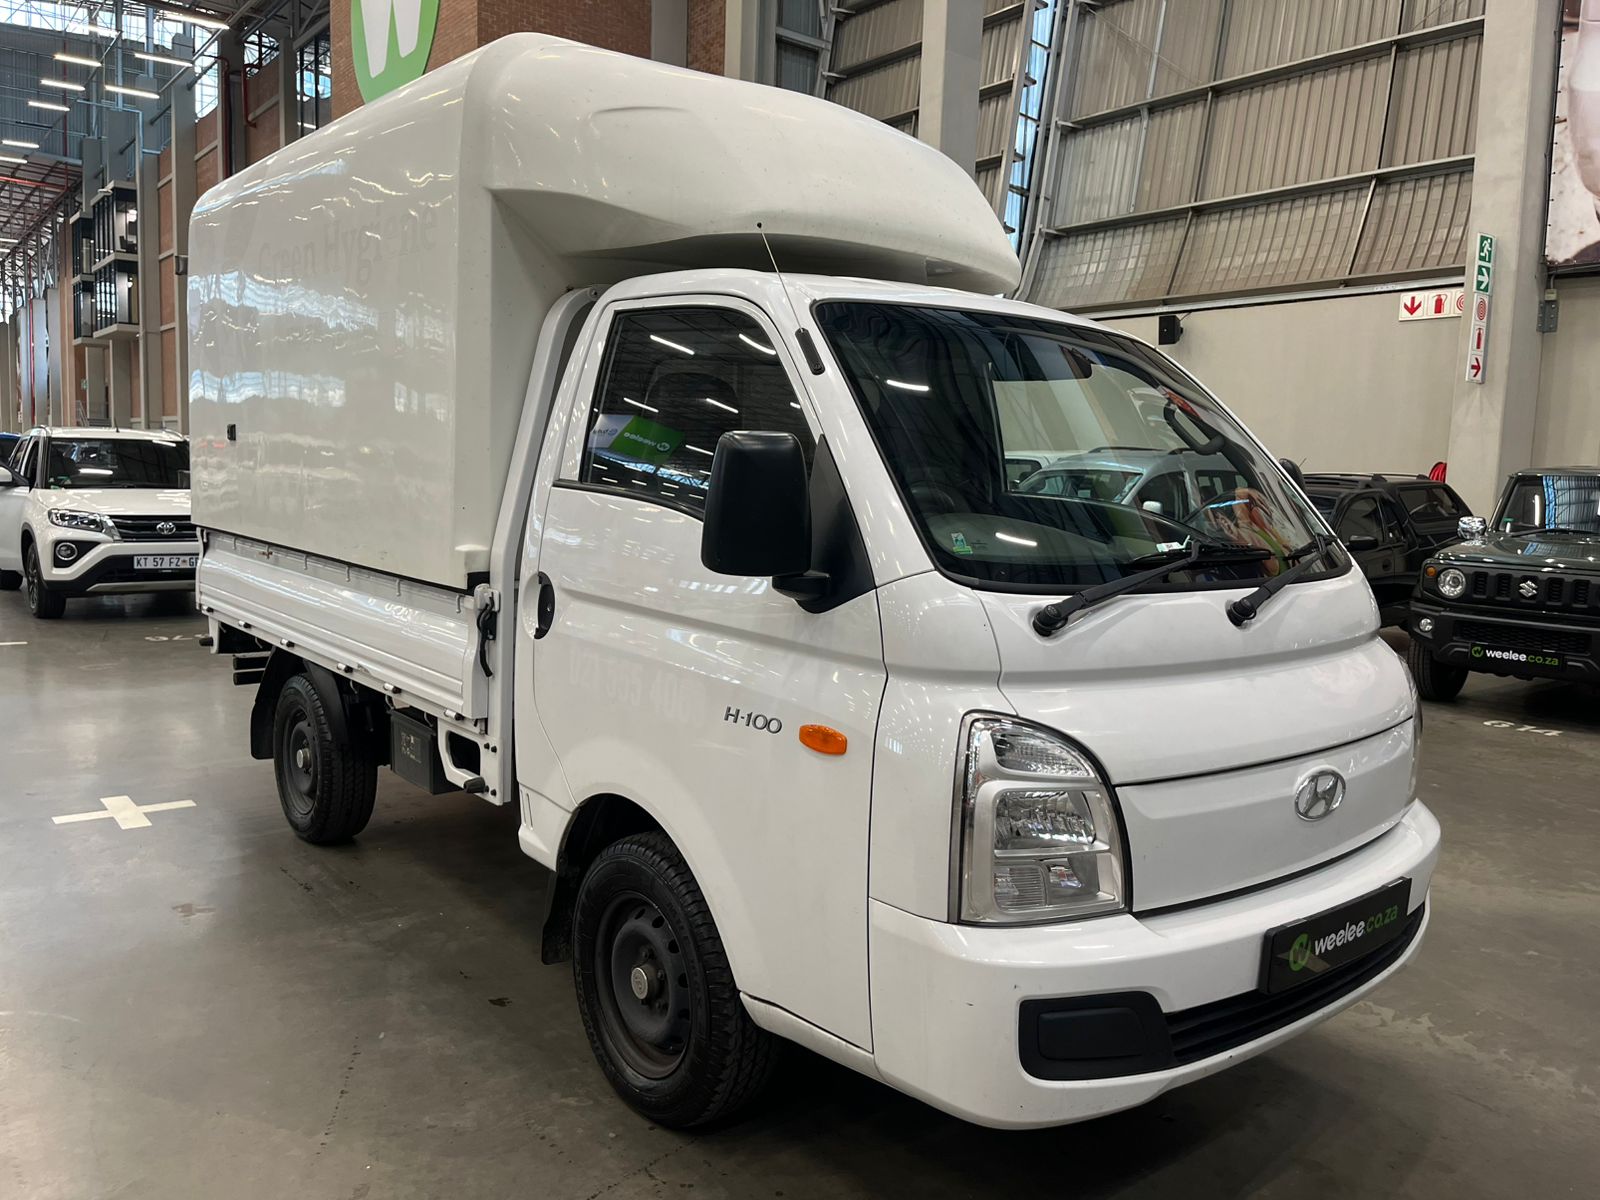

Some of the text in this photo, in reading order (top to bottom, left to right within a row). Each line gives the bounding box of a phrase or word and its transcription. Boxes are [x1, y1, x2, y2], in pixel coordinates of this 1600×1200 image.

[136, 557, 148, 568] KT
[152, 557, 165, 568] 57
[169, 557, 181, 568] FZ
[1485, 649, 1559, 666] weelee.co.za
[723, 706, 783, 734] H-100
[1314, 904, 1399, 956] weelee.co.za
